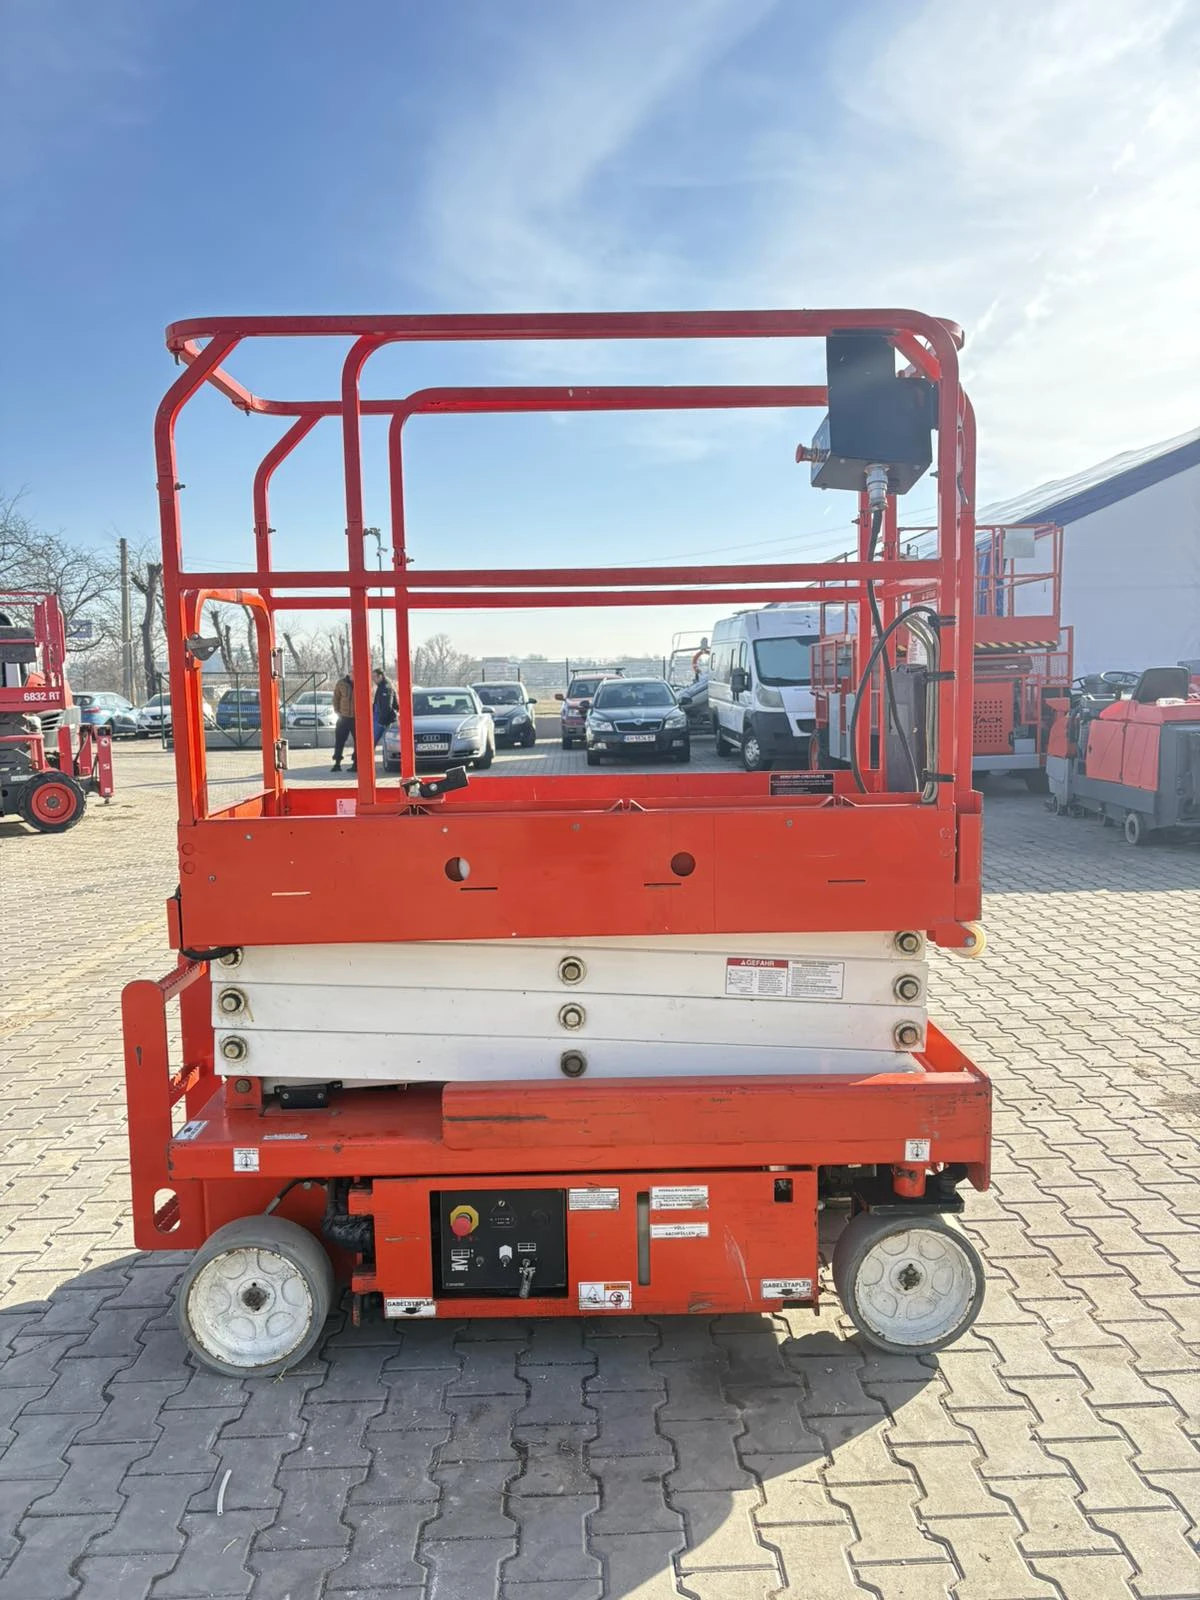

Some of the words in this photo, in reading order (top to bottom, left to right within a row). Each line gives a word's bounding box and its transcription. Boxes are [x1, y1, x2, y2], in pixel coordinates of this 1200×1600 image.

[23, 692, 47, 702] 6832
[49, 691, 61, 701] RT
[744, 959, 775, 967] GEFAHR
